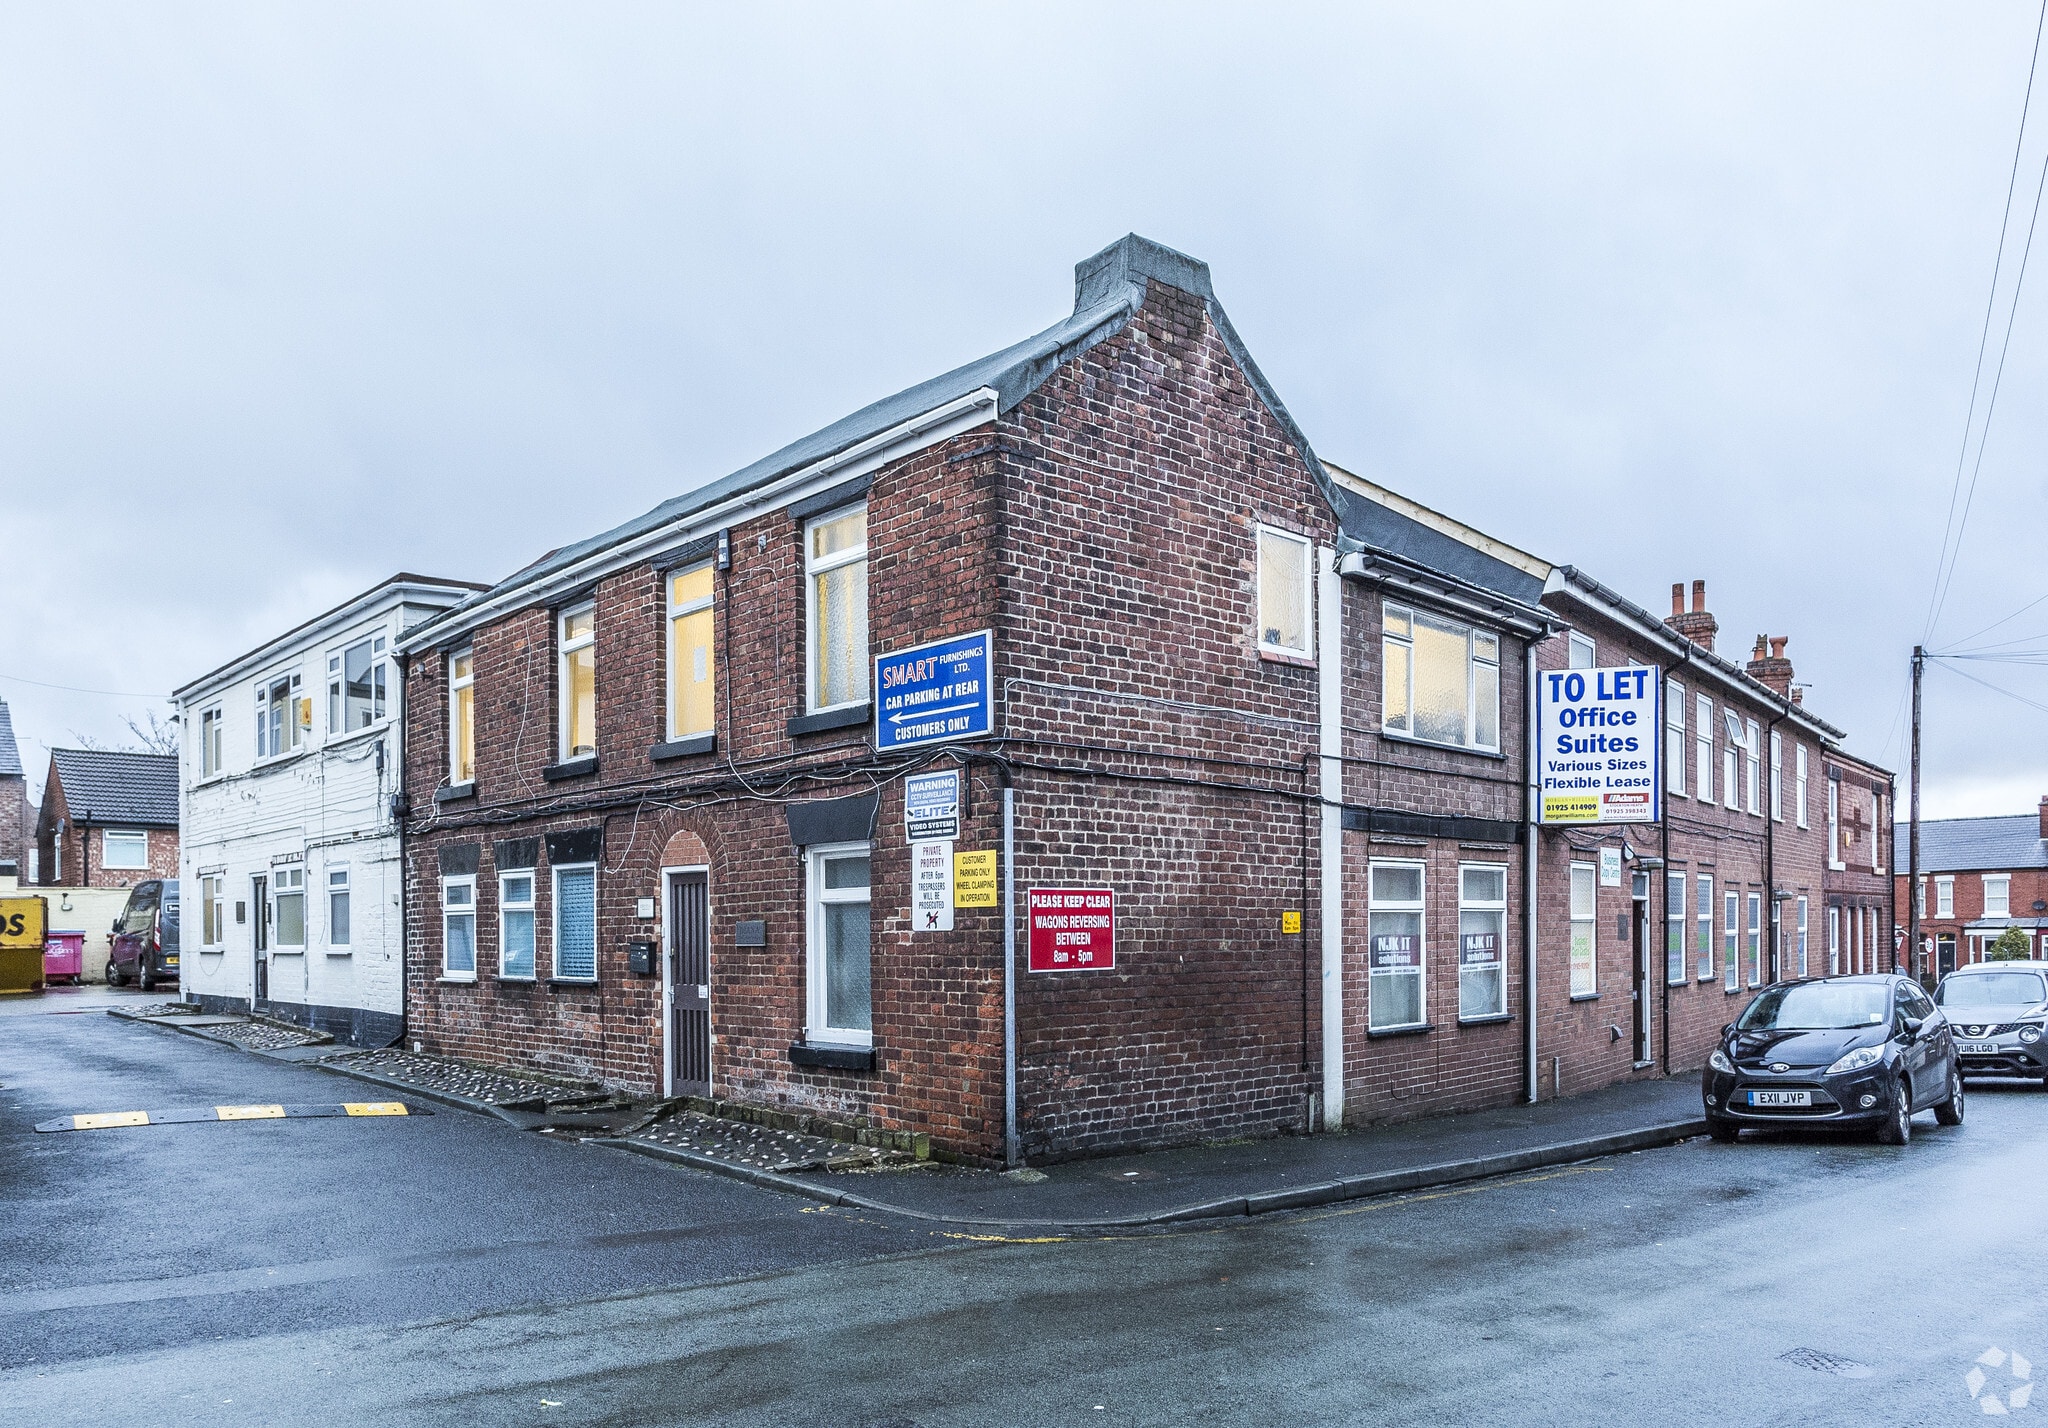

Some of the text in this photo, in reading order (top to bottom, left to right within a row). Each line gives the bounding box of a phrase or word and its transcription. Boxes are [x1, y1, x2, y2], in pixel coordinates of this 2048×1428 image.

[883, 646, 983, 689] SMART FURNISHINGS
[954, 662, 970, 674] LTD.
[1548, 670, 1648, 703] TO LET
[886, 680, 979, 710] CAR PARKING AT REAR
[1559, 707, 1637, 728] Office
[895, 716, 970, 741] CUSTOMERS ONLY
[1556, 733, 1639, 754] Suites
[1548, 758, 1647, 772] Various Sizes
[909, 778, 955, 793] WARNING
[1544, 776, 1651, 789] Flexible Lease
[1615, 793, 1644, 803] Adams
[914, 806, 950, 818] ELITE
[909, 820, 955, 831] VIDEO SYSTEMS
[922, 845, 941, 856] PRIVATE
[920, 857, 944, 868] PROPERTY
[962, 855, 986, 864] CUSTOMER
[921, 871, 933, 880] AFTER
[959, 868, 990, 877] PARKING ONLY
[918, 882, 945, 891] TRESPASSERS
[956, 880, 994, 890] WHEEL CLAMPING
[923, 891, 940, 900] WILL BE
[960, 893, 990, 902] IN OPERATION
[1031, 895, 1110, 908] PLEASE KEEP CLEAR
[918, 901, 944, 909] PROSECUTED
[1035, 915, 1109, 928] WAGONS REVERSING
[1055, 932, 1091, 945] BETWEEN
[1378, 936, 1411, 951] NJK IT
[1467, 935, 1494, 949] NJK IT
[1053, 950, 1068, 962] 8am
[1078, 949, 1093, 964] 5pm
[1378, 953, 1411, 965] solutions
[1467, 951, 1494, 962] solutions
[1760, 1093, 1804, 1104] EX11 JVP
